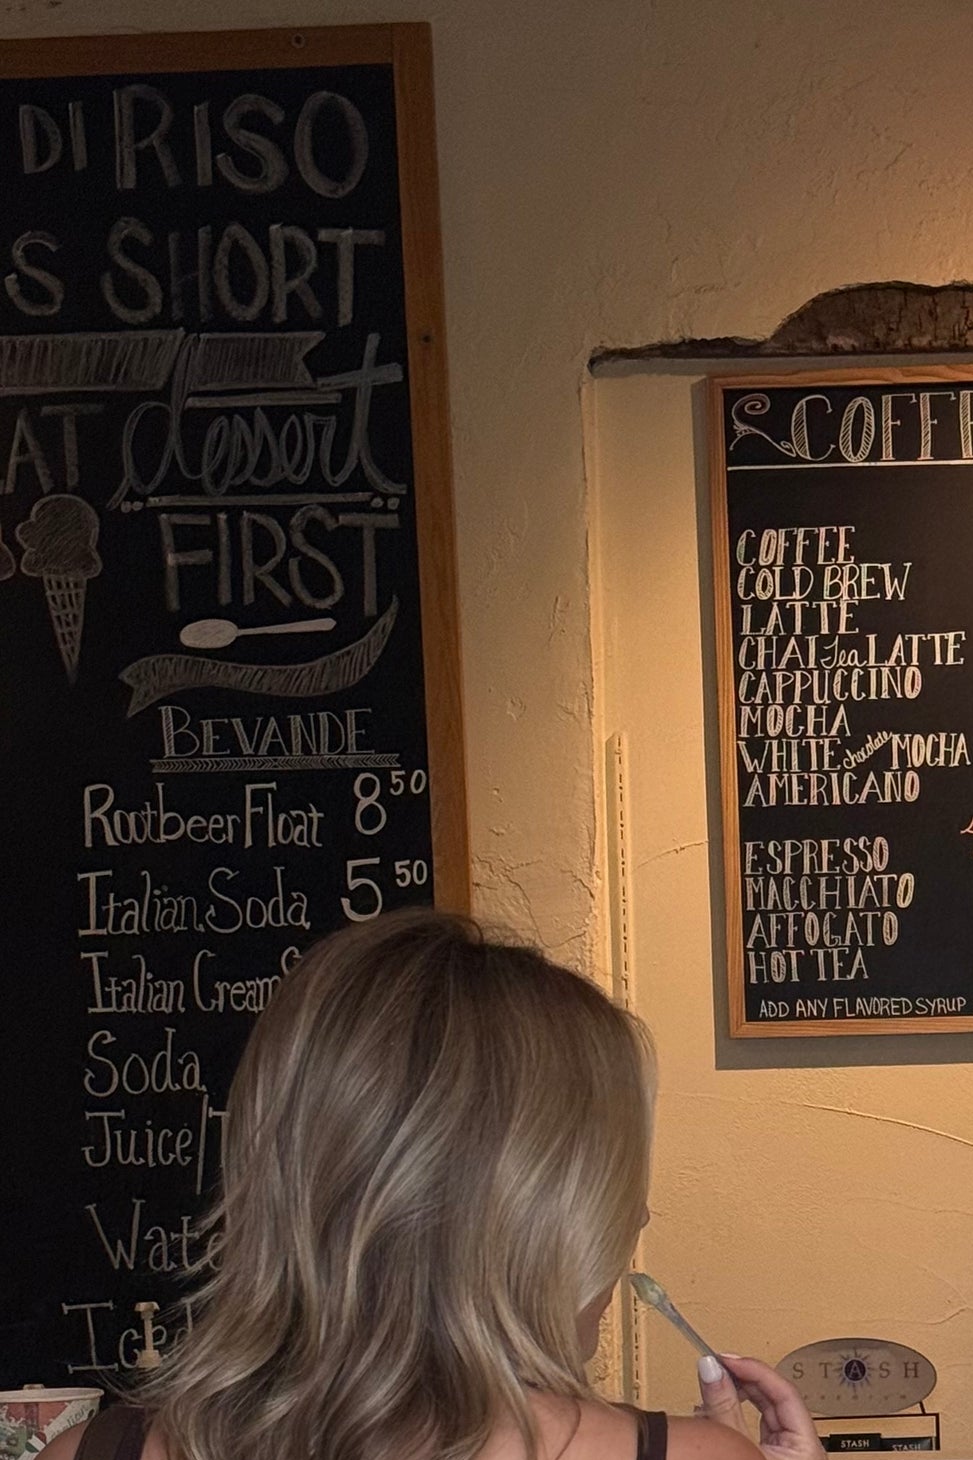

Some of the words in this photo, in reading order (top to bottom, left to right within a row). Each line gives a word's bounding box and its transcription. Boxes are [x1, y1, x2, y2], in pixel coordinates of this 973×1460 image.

[112, 84, 370, 199] RISO
[103, 215, 386, 327] SHORT
[0, 402, 104, 494] AT
[107, 333, 407, 509] dessert
[158, 505, 399, 617] FIRST
[736, 525, 856, 567] COFFEE
[737, 565, 815, 601] COLD
[822, 562, 913, 601] BREW
[740, 600, 860, 637] LATTE
[738, 635, 820, 670] CHAI
[865, 630, 967, 668] LATTE
[738, 665, 923, 705] CAPPUCCINO
[157, 705, 377, 759] BEVANDE
[738, 703, 852, 738] MOCHA
[737, 738, 842, 774] WHITE
[842, 730, 895, 770] chocolate
[891, 731, 972, 769] MOCHA
[743, 771, 921, 808] AMERICANO
[244, 781, 325, 849] Float
[743, 836, 890, 876] ESPRESSO
[77, 868, 205, 938] Italian
[205, 866, 312, 935] Soda
[744, 872, 915, 911] MACCHIATO
[746, 910, 899, 949] AFFOGATO
[80, 950, 186, 1015] Italian
[748, 948, 804, 985] HOT
[811, 946, 869, 983] TEA
[759, 1000, 790, 1019] ADD
[795, 998, 829, 1018] ANY
[832, 997, 913, 1018] FLAVORED
[914, 996, 967, 1017] SYRUP
[83, 1027, 207, 1098] Soda
[85, 1198, 226, 1273] Wate
[792, 1358, 920, 1382] STASH
[840, 1439, 870, 1449] STASH
